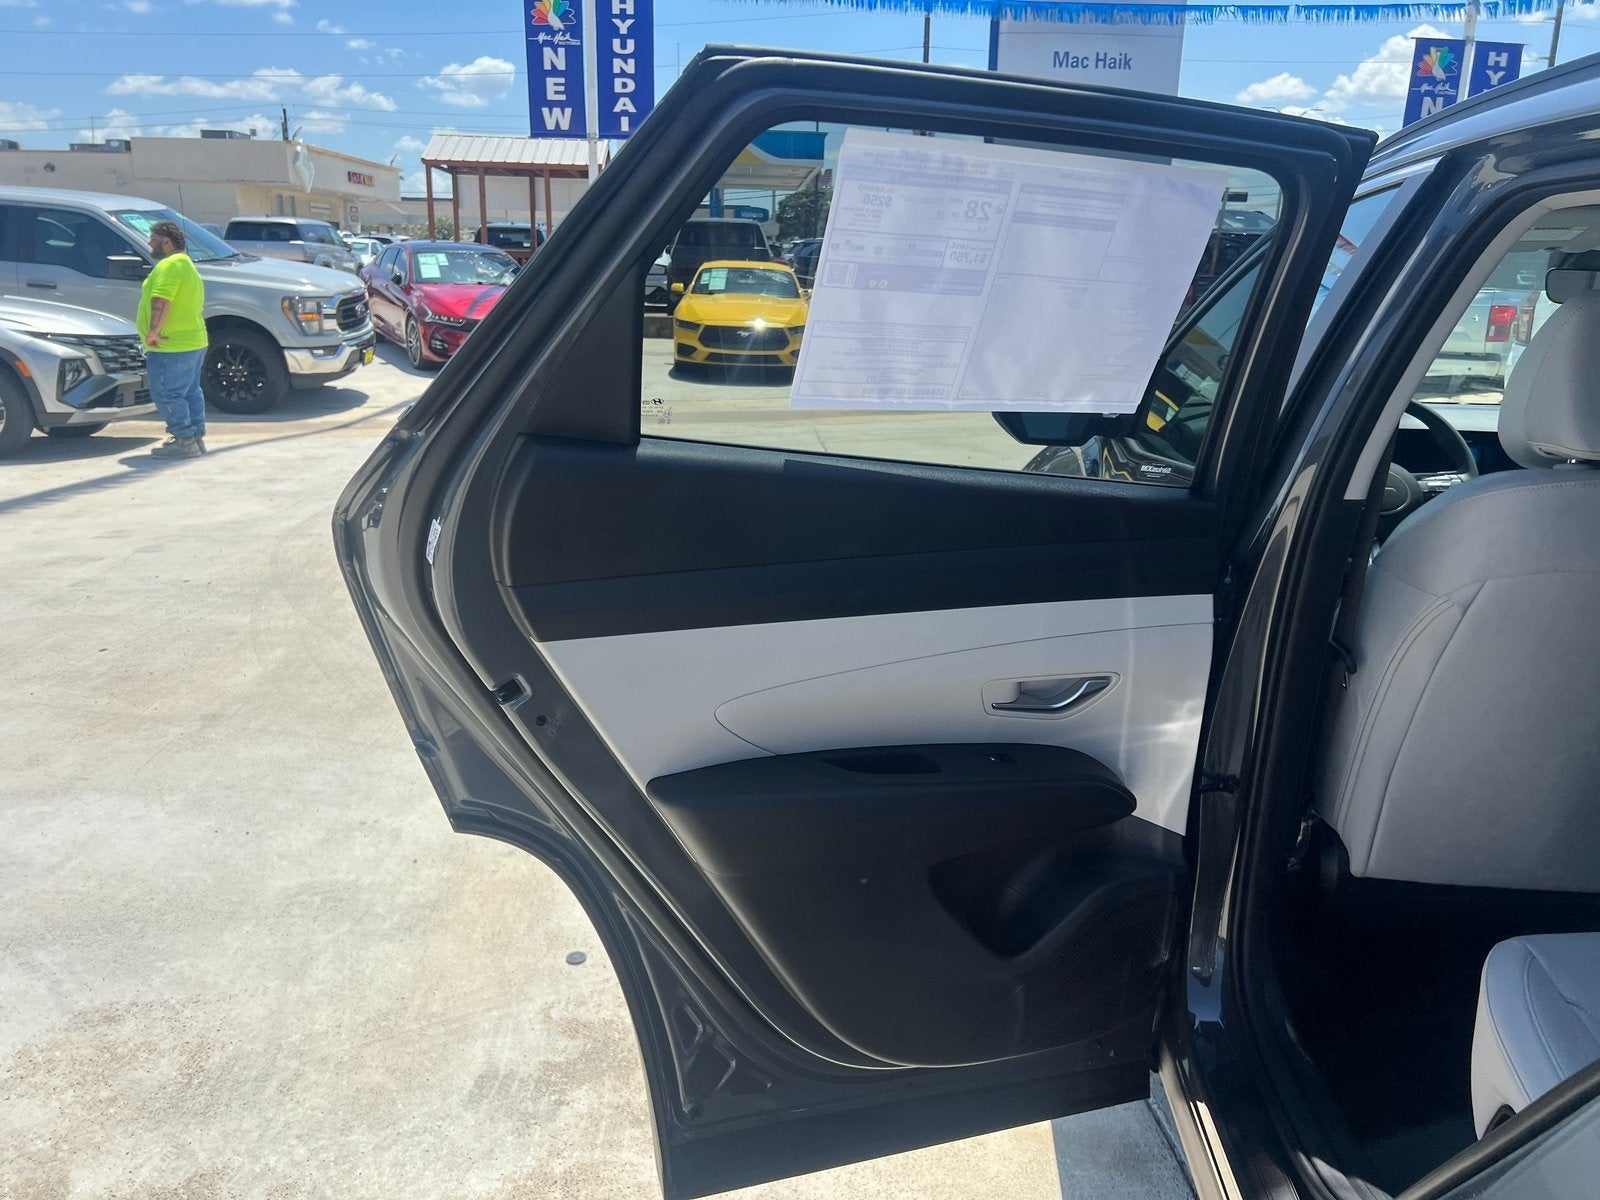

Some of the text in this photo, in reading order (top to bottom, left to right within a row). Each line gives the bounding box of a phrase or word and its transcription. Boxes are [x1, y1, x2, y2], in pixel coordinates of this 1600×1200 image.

[541, 46, 573, 131] NEW
[611, 0, 637, 132] HYUNDAI
[1053, 51, 1133, 70] Mac Haik
